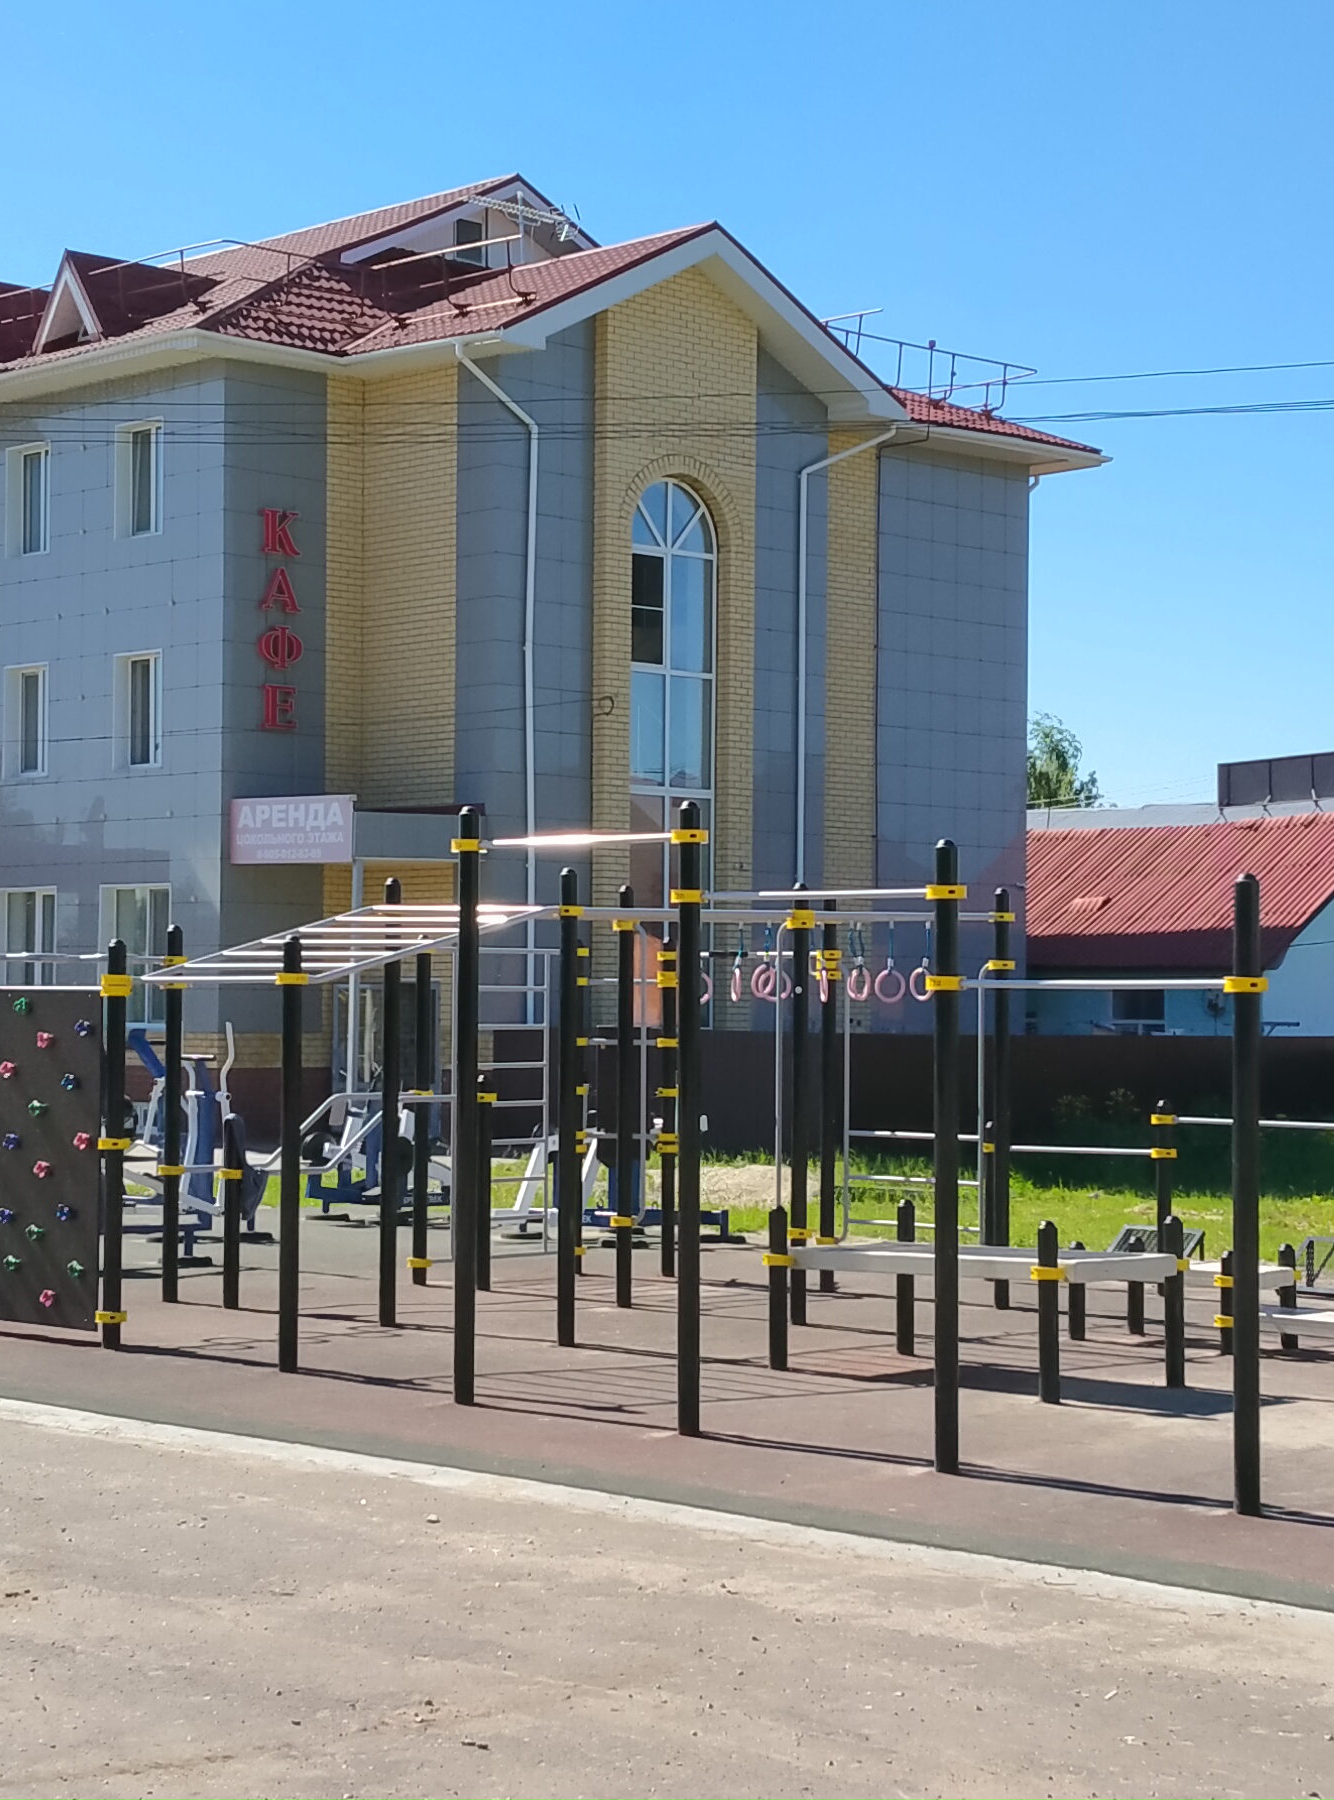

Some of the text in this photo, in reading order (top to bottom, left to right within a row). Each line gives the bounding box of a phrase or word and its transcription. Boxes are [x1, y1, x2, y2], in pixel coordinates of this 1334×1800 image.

[258, 508, 304, 731] КАФЕ
[237, 802, 344, 831] АРЕНДА
[236, 831, 344, 846] ЦОКОЛЬНОГО ЭТАЖА
